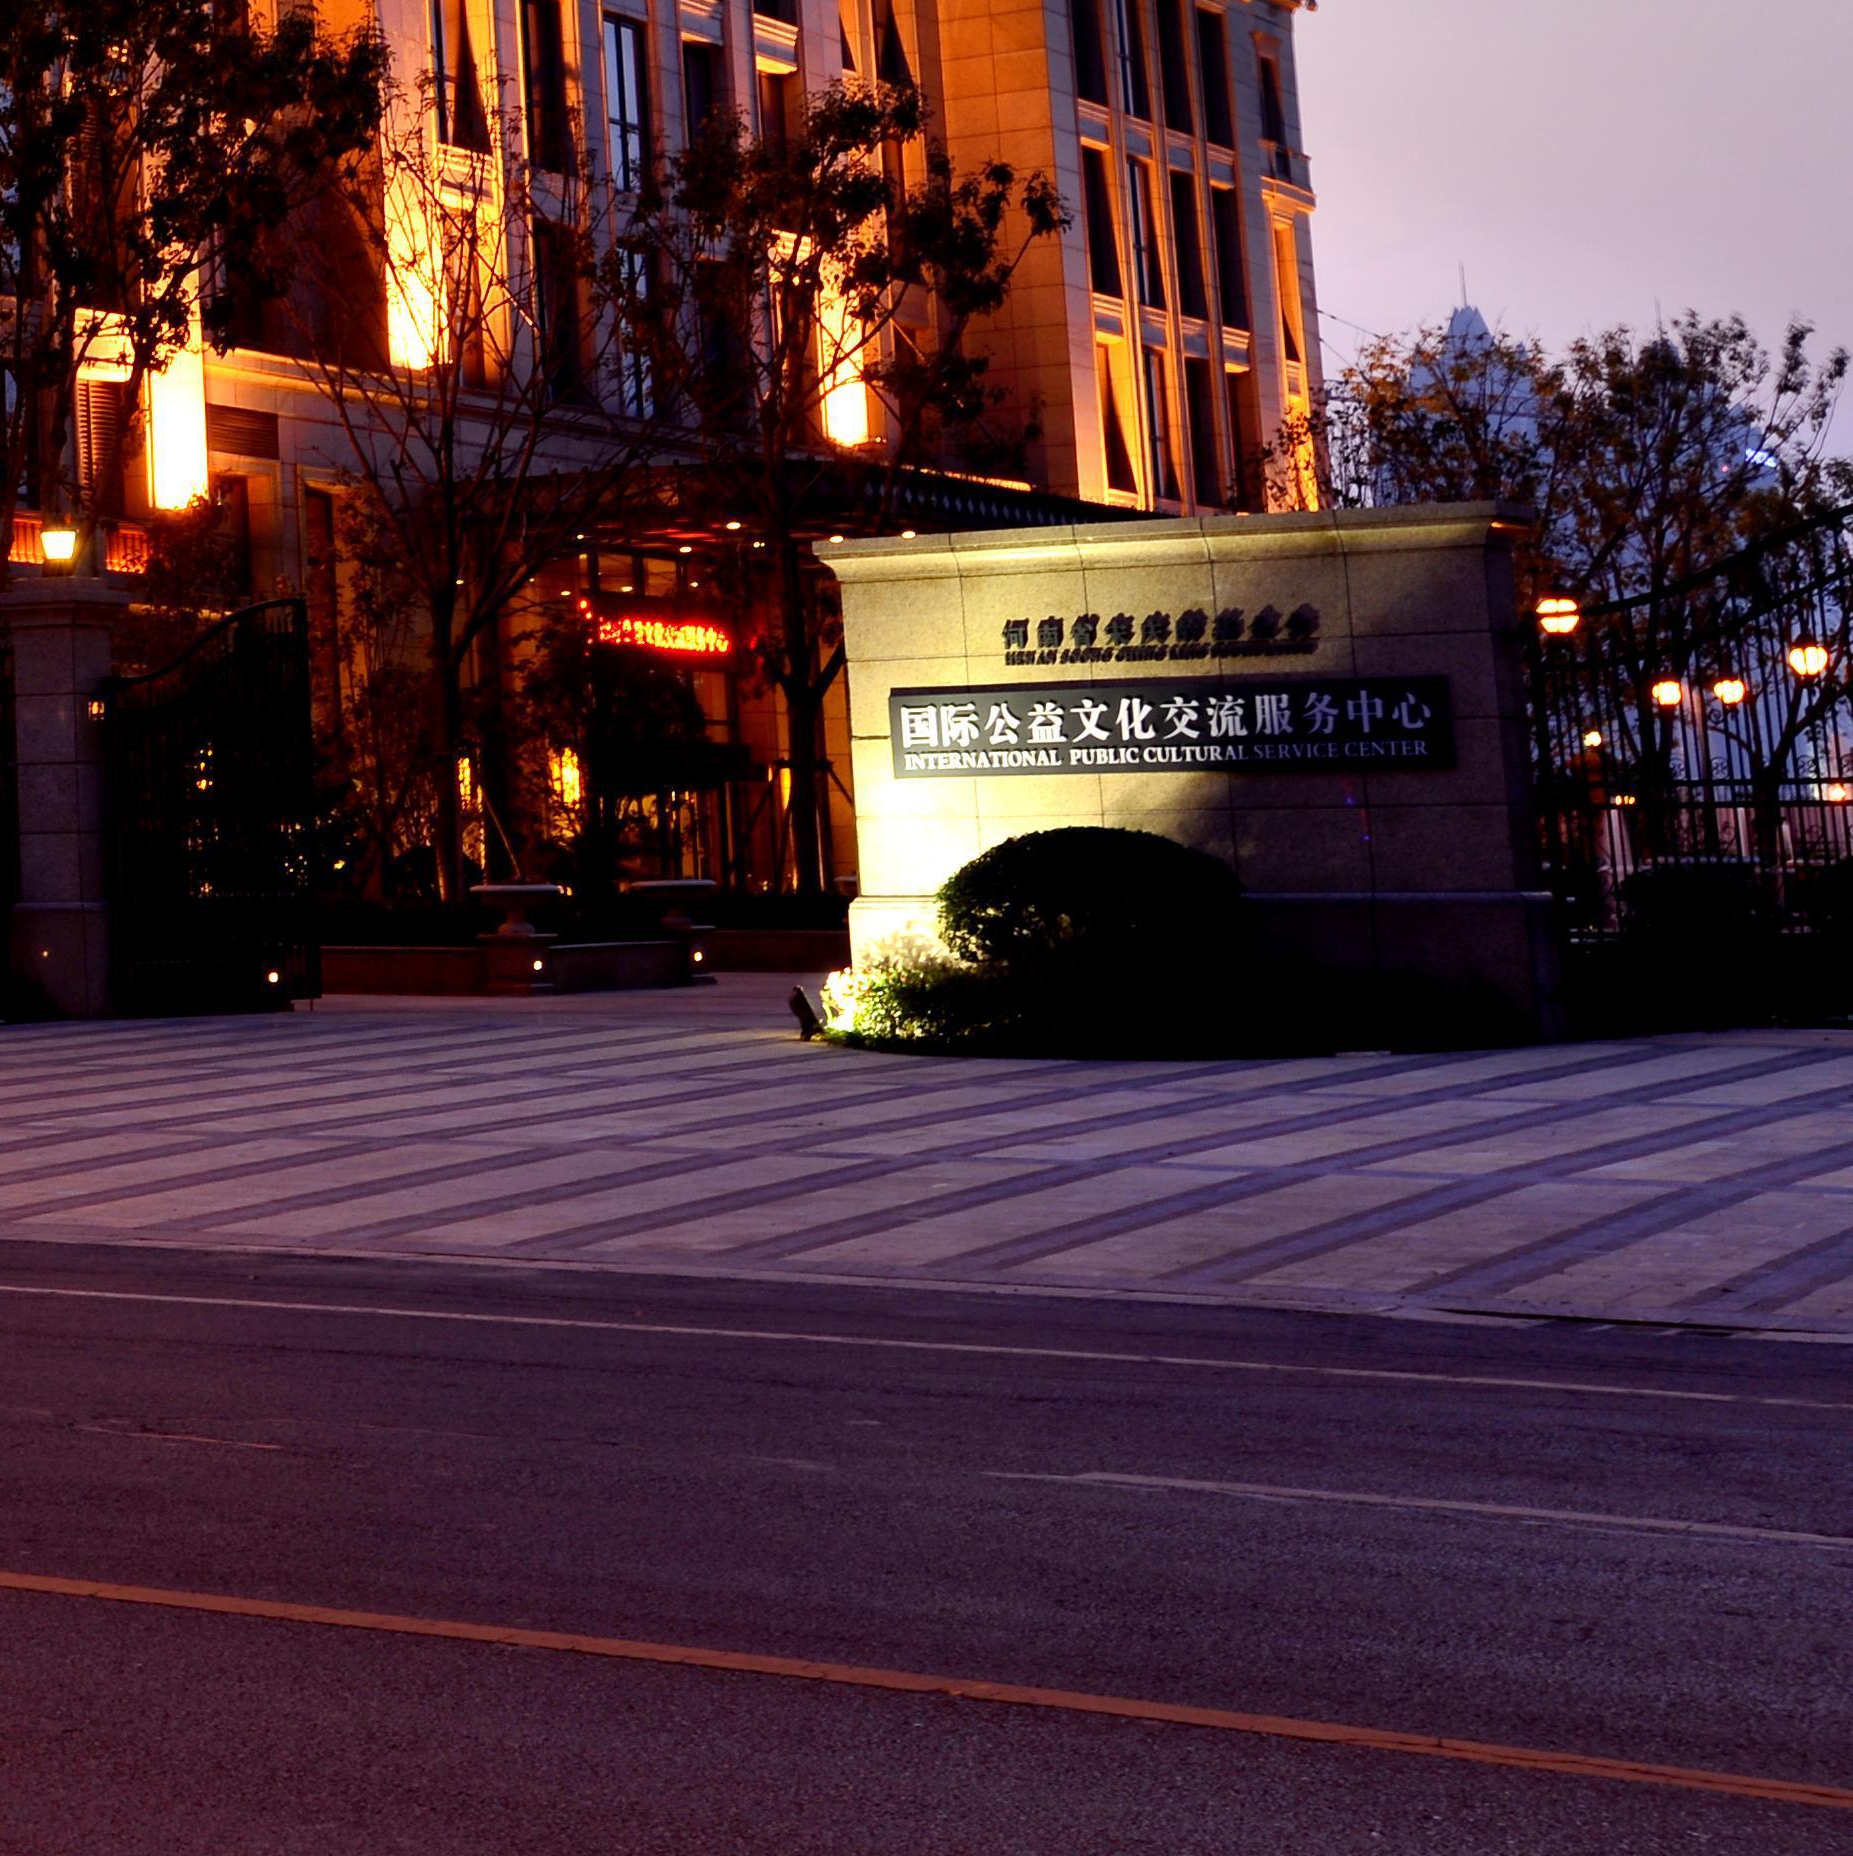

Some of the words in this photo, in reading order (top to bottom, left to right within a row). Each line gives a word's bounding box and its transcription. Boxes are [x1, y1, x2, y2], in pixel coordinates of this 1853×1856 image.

[899, 690, 1432, 748] 国际公益文化交流服务中心
[904, 750, 1061, 771] INTERNATIONAL
[1069, 747, 1139, 766] PUBLIC
[1143, 745, 1248, 765] CULTURAL
[1253, 742, 1339, 760] SERVICE
[1344, 740, 1428, 757] CENTER
